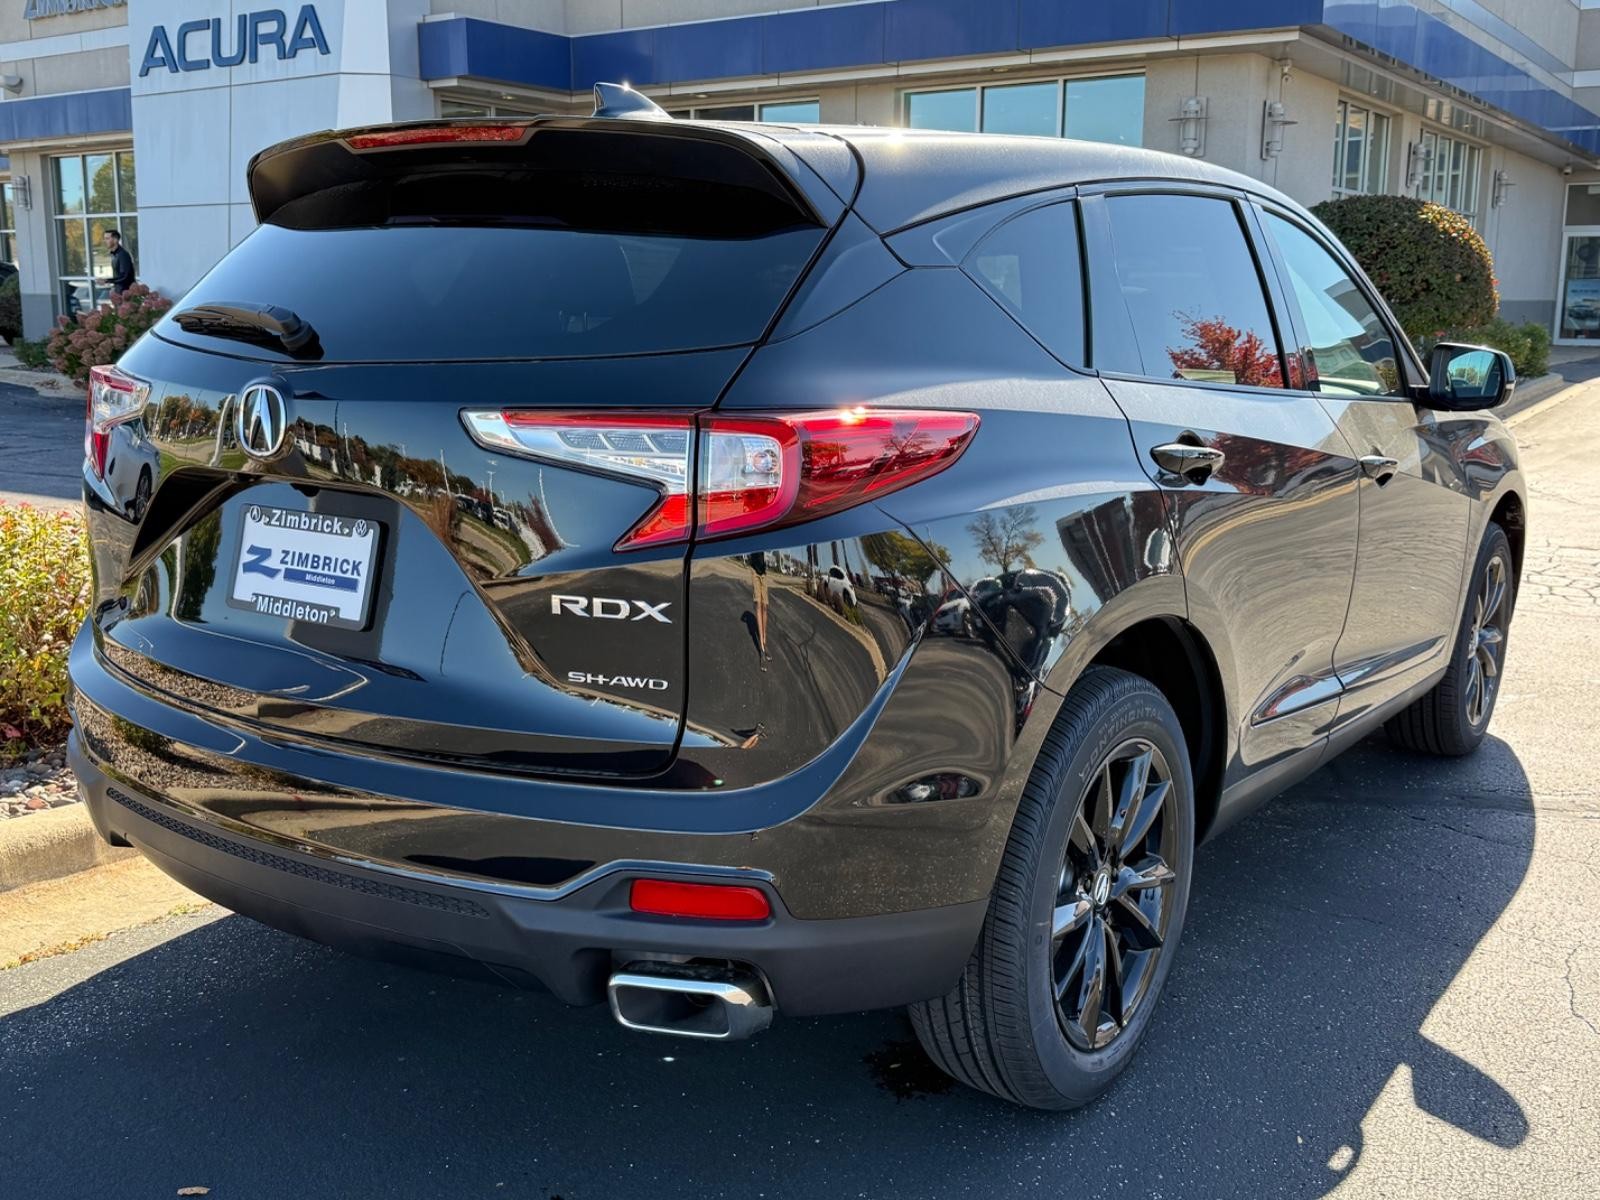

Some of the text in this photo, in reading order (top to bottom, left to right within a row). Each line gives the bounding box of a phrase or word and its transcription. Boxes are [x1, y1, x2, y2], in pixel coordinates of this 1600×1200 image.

[138, 4, 331, 77] ACURA
[270, 509, 343, 535] Zimbrick
[279, 549, 362, 577] ZIMBRICK
[305, 573, 336, 585] Middleton
[256, 596, 329, 624] Middleton
[551, 594, 673, 624] RDX
[568, 671, 669, 690] SH-AWD
[1078, 706, 1164, 783] CONTINENTAL
